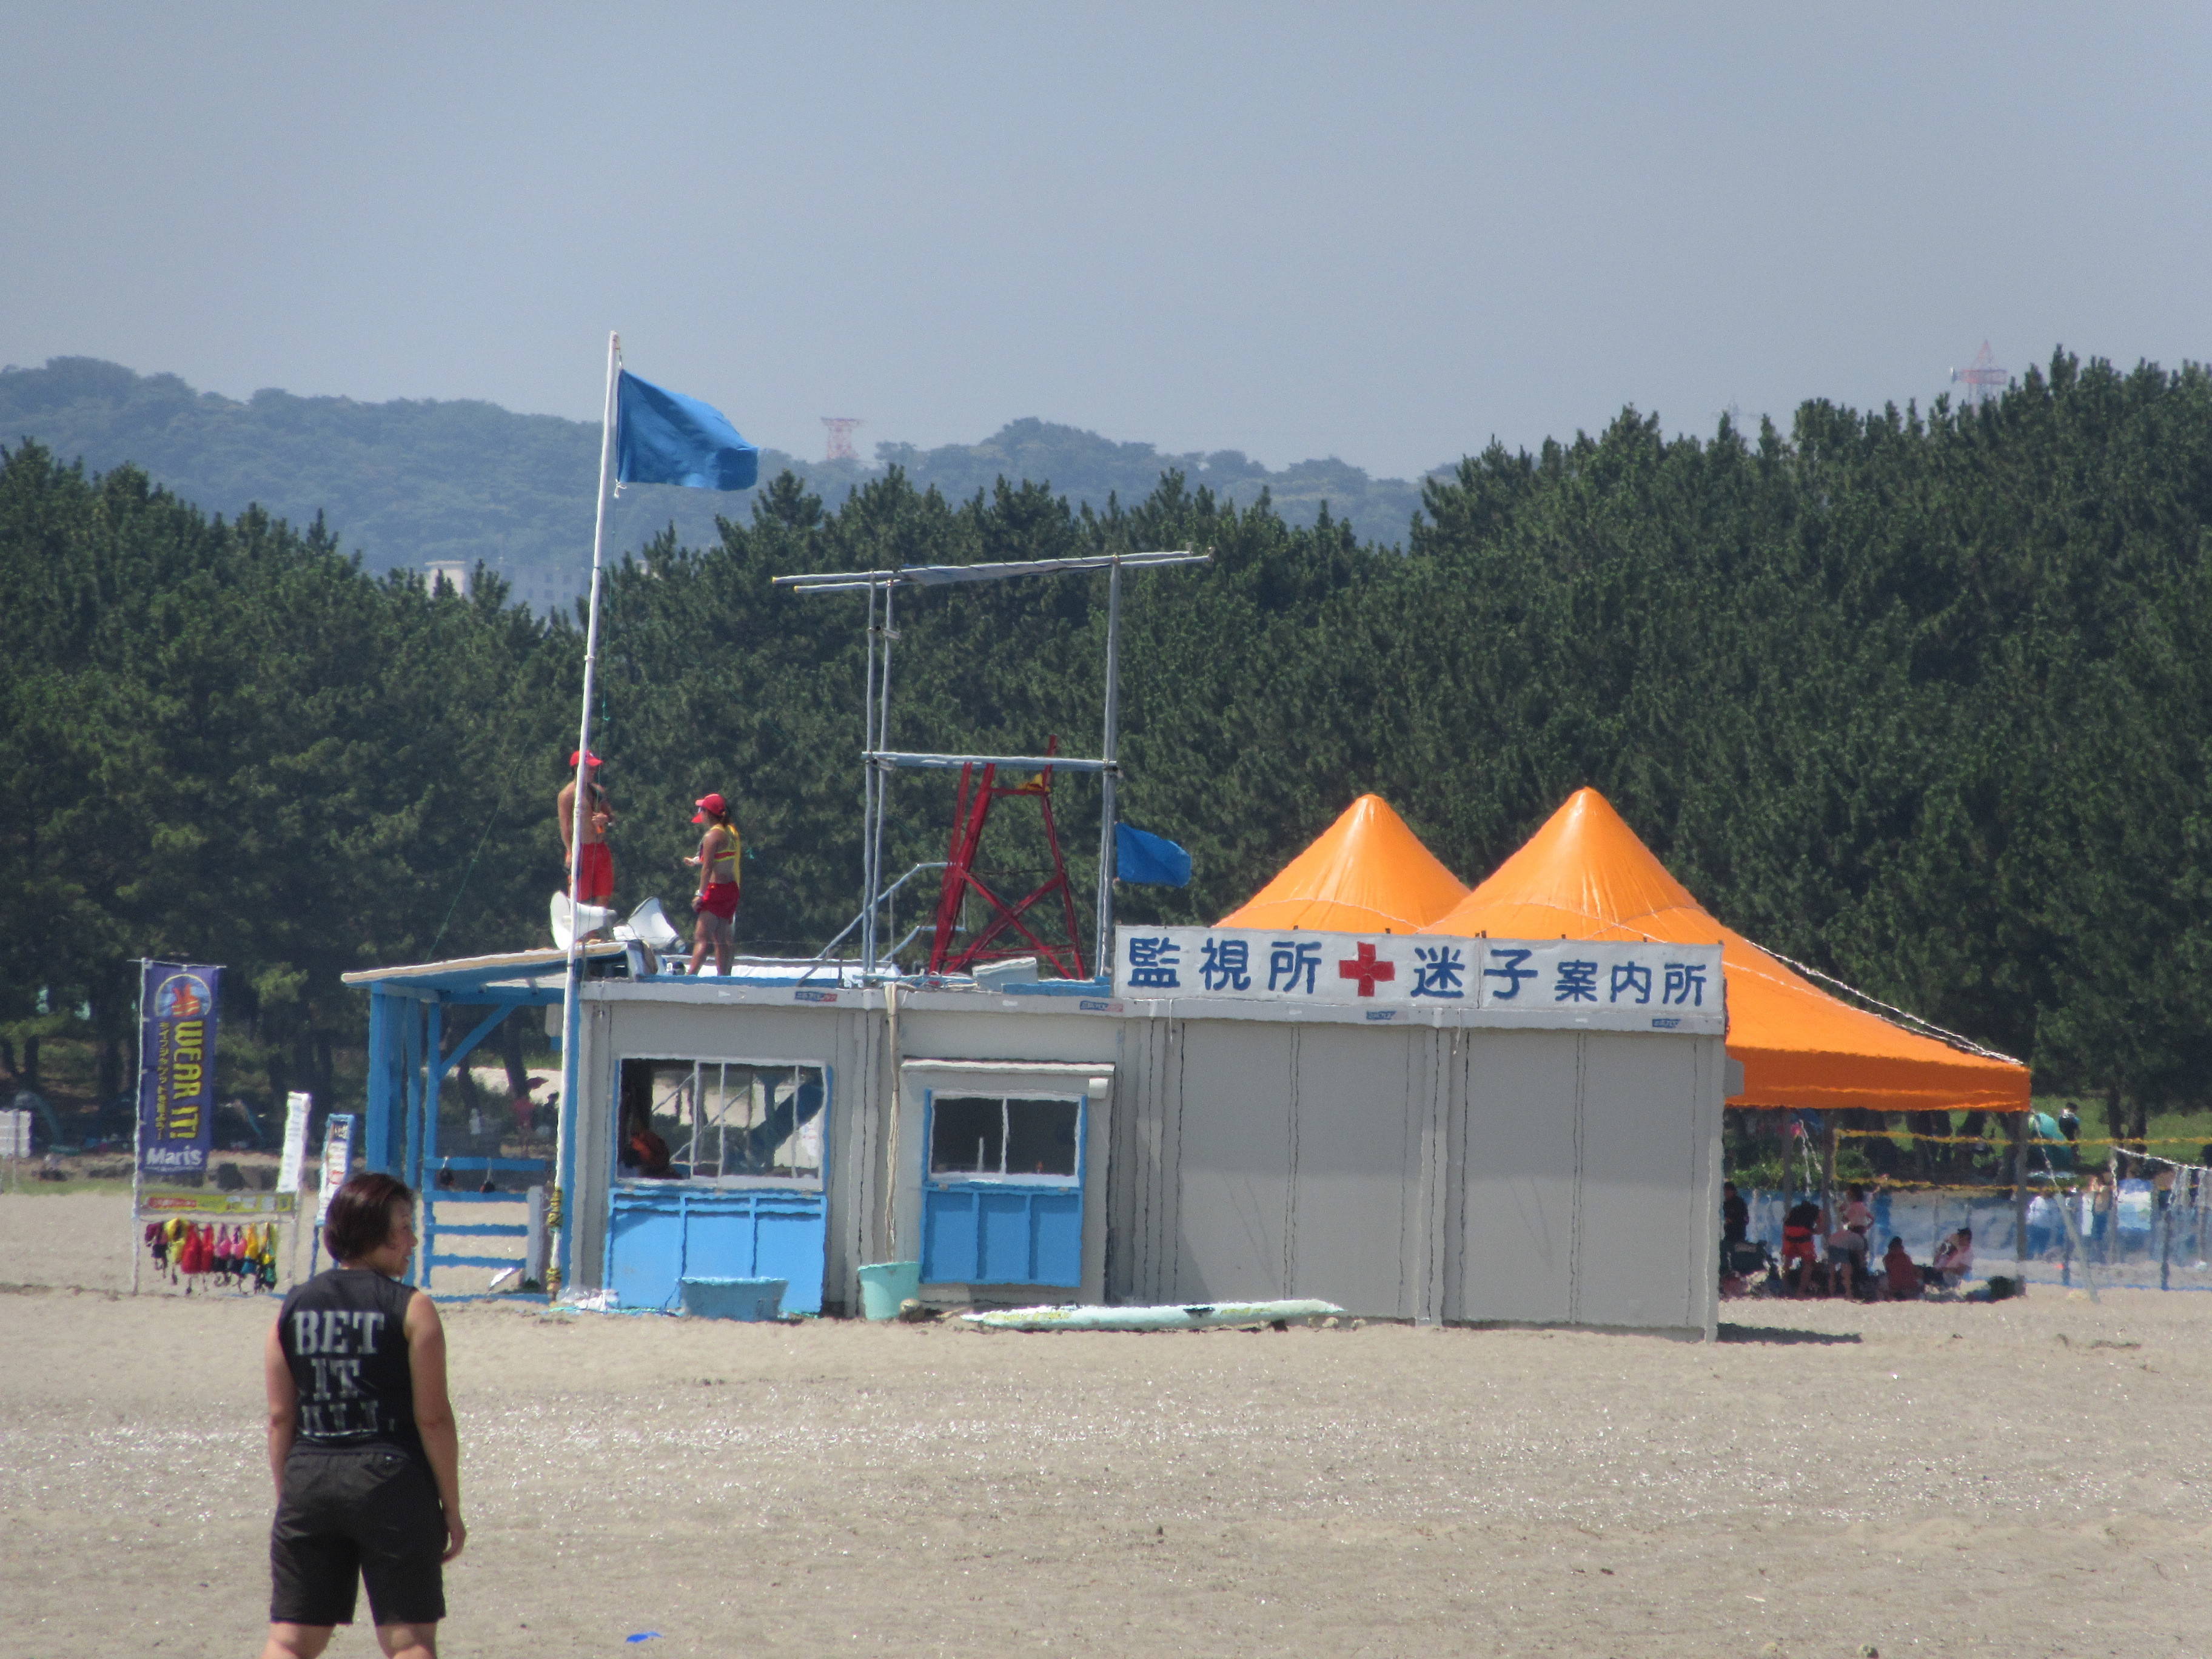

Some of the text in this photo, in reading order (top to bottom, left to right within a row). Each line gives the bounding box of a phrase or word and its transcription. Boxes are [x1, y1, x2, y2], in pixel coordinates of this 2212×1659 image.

[1127, 937, 1324, 994] 監視所
[1410, 945, 1706, 1007] 迷子案内所
[172, 1020, 204, 1099] WEAR
[169, 1105, 200, 1139] IT!
[146, 1145, 203, 1165] Maris
[293, 1310, 385, 1356] BET
[311, 1358, 360, 1401] IT
